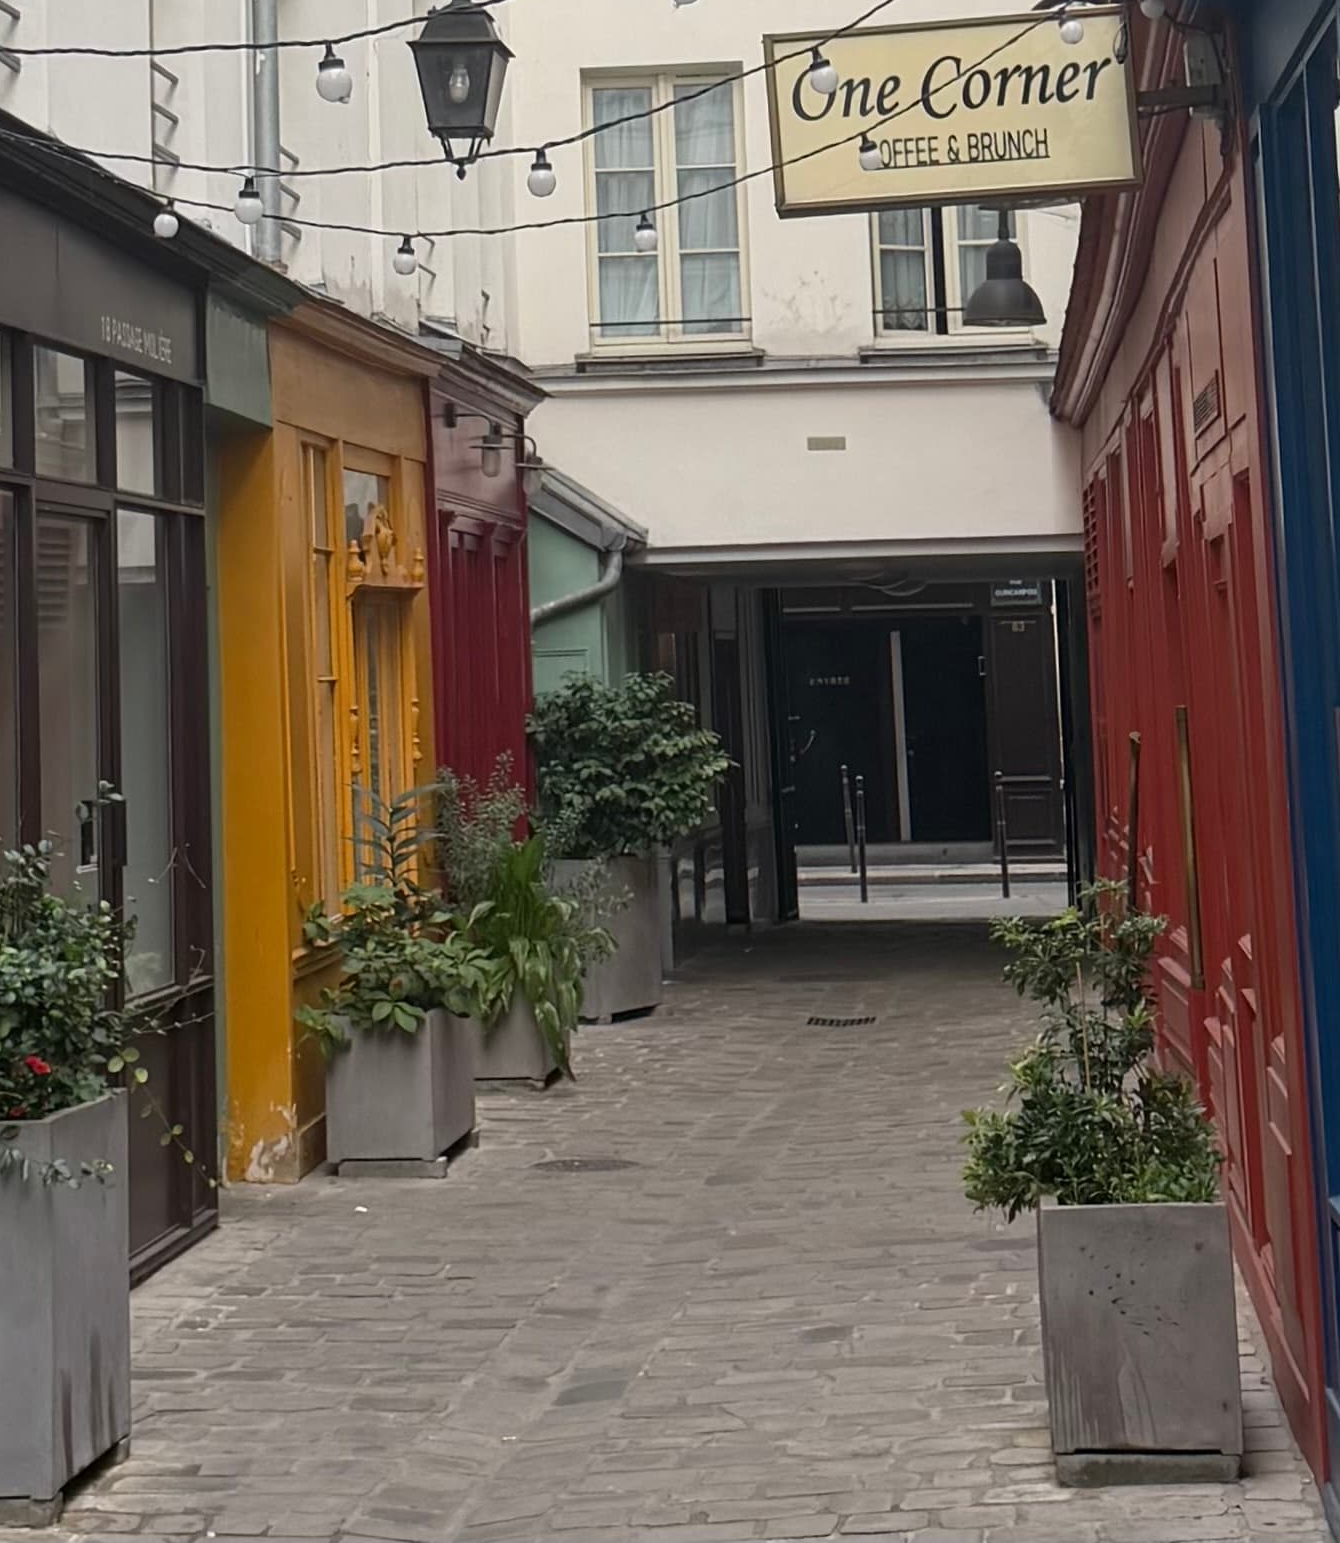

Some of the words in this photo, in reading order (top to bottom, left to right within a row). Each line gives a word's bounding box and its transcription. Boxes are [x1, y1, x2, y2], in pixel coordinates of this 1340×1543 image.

[791, 67, 901, 122] One
[920, 55, 1113, 120] Corner
[868, 134, 940, 168] OFFEE
[947, 134, 961, 162] &
[968, 127, 1050, 162] BRUNCH
